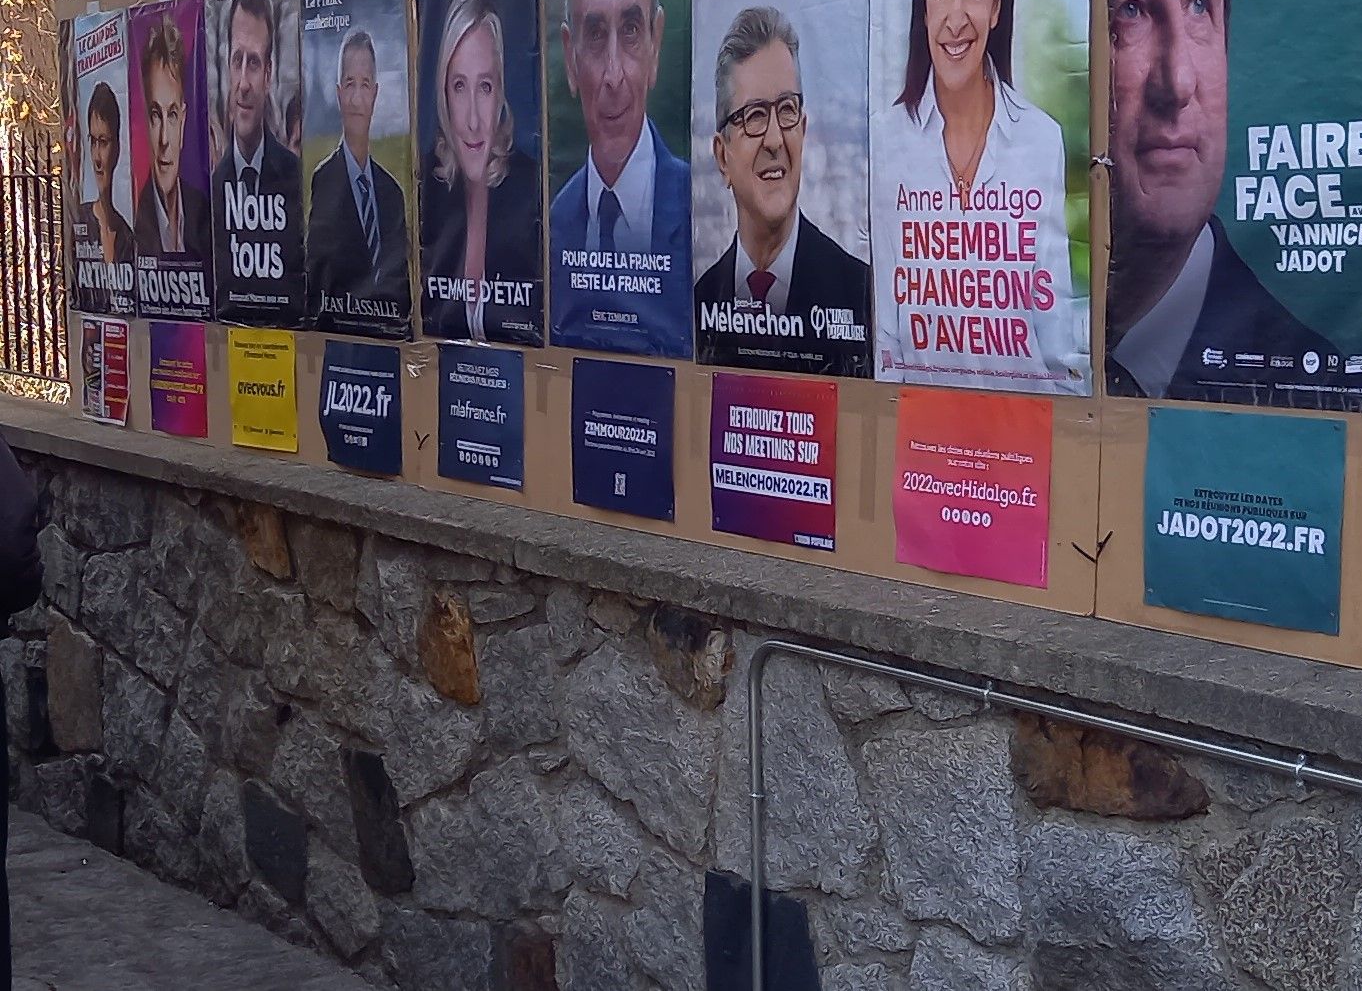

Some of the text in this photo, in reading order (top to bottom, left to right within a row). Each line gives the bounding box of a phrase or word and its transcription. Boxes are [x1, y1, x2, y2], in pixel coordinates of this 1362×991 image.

[224, 181, 287, 231] Nous
[897, 181, 1042, 219] Anne Hidalgo
[1235, 174, 1346, 221] FACE
[230, 233, 284, 279] tous
[901, 221, 1037, 262] ENSEMBLE
[562, 250, 671, 271] POUR QUE LA FRANCE
[1276, 250, 1347, 273] JADOT
[138, 270, 210, 305] ROUSSEL
[427, 273, 534, 306] FEMME D'ÉTAT
[570, 272, 662, 294] RESTE LA FRANCE
[894, 266, 1055, 311] CHANGEONS
[700, 301, 804, 338] Mélenchon
[910, 313, 1032, 358] D'AVENIR
[237, 380, 286, 398] avecvous.fr
[323, 380, 392, 417] JL2022.fr
[450, 399, 507, 425] mlafrance.fr
[729, 405, 815, 436] RETROUVEZ TOUS
[723, 431, 819, 465] NOS MEETINGS SUR
[715, 467, 828, 501] MELENCHON2022.FR
[902, 472, 1038, 508] 2022avecHidalgo.fr
[1255, 495, 1283, 506] DATES
[1157, 510, 1325, 554] JADOT2022.FR
